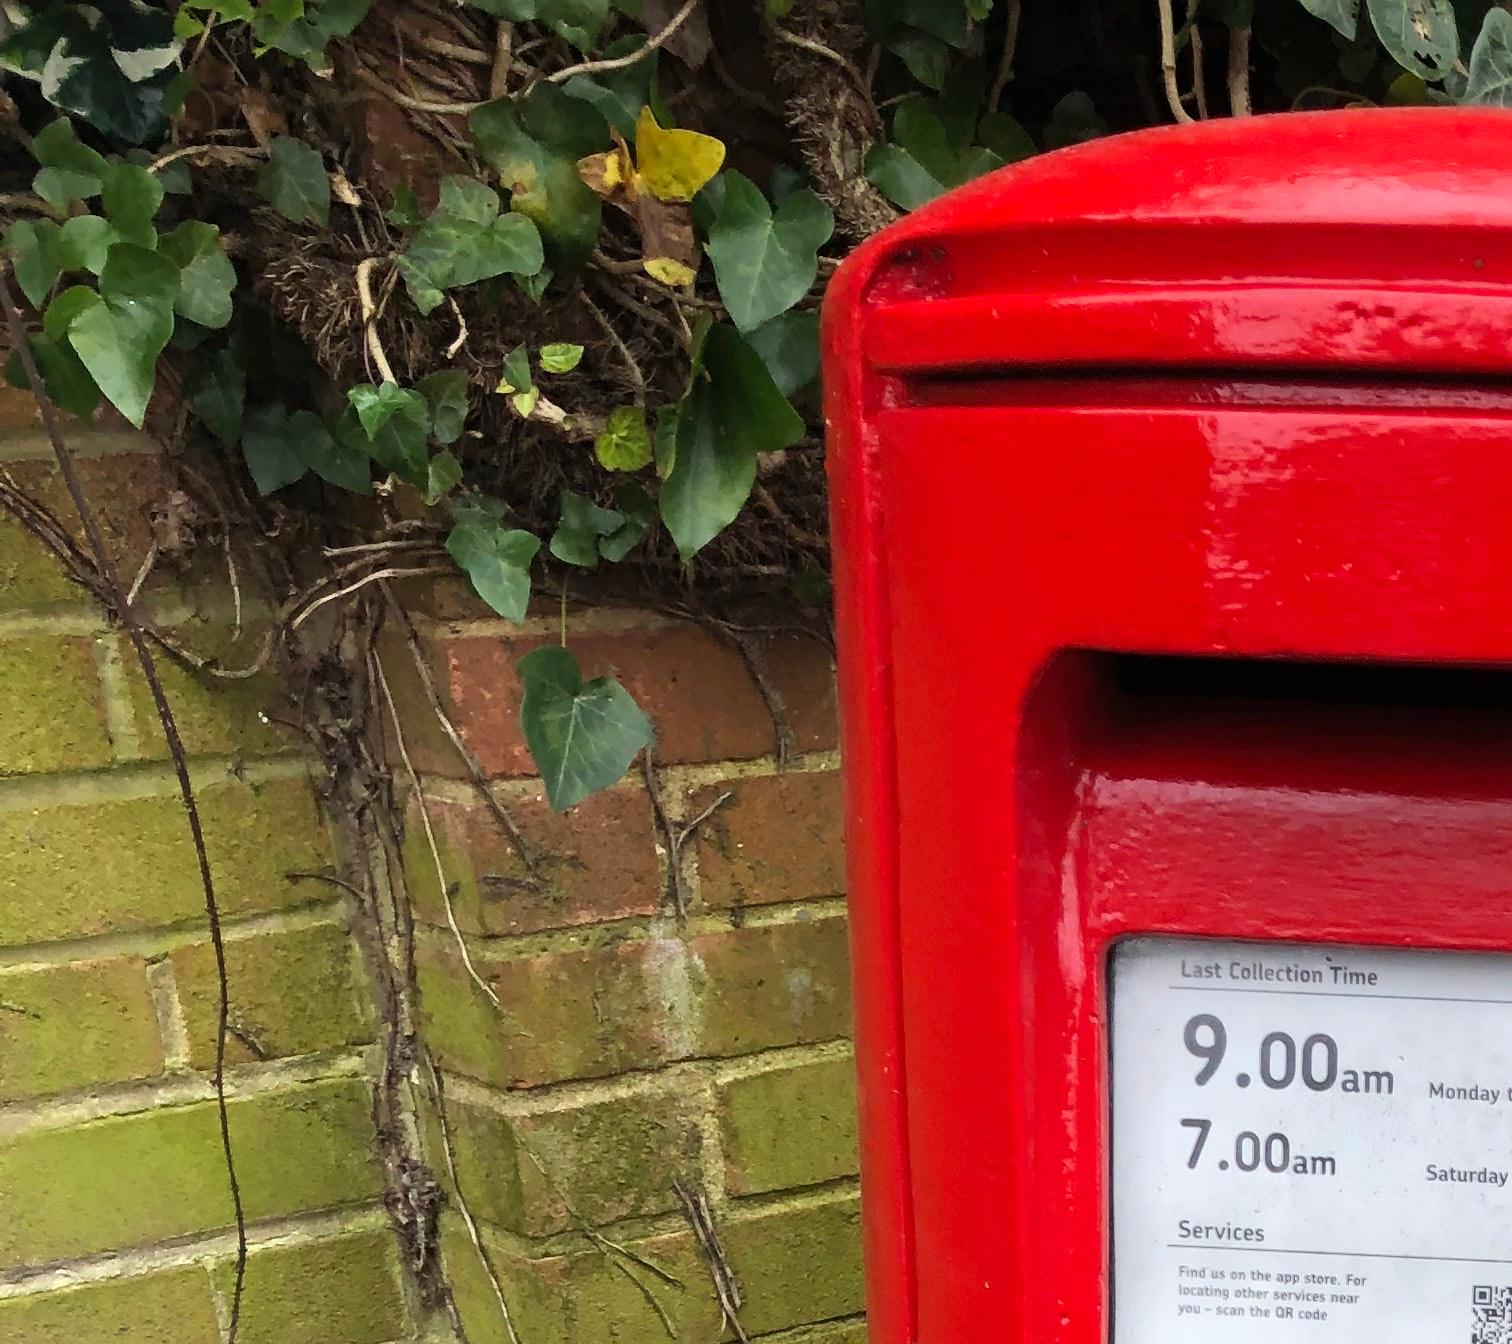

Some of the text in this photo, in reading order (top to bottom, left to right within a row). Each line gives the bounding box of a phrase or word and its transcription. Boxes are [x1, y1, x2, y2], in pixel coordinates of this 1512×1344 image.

[1181, 960, 1378, 986] Last Collection Time
[1183, 1013, 1394, 1095] 9.00am
[1428, 1081, 1500, 1106] Monday
[1180, 1118, 1336, 1176] 7.00am
[1426, 1164, 1509, 1188] Saturday
[1178, 1219, 1265, 1242] Services
[1178, 1265, 1367, 1287] Find us on the app store. For
[1178, 1284, 1360, 1305] locating other services near
[1177, 1303, 1201, 1316] you
[1216, 1305, 1245, 1317] scan
[1250, 1304, 1271, 1318] the
[1274, 1306, 1294, 1320] QR
[1298, 1308, 1328, 1321] code
